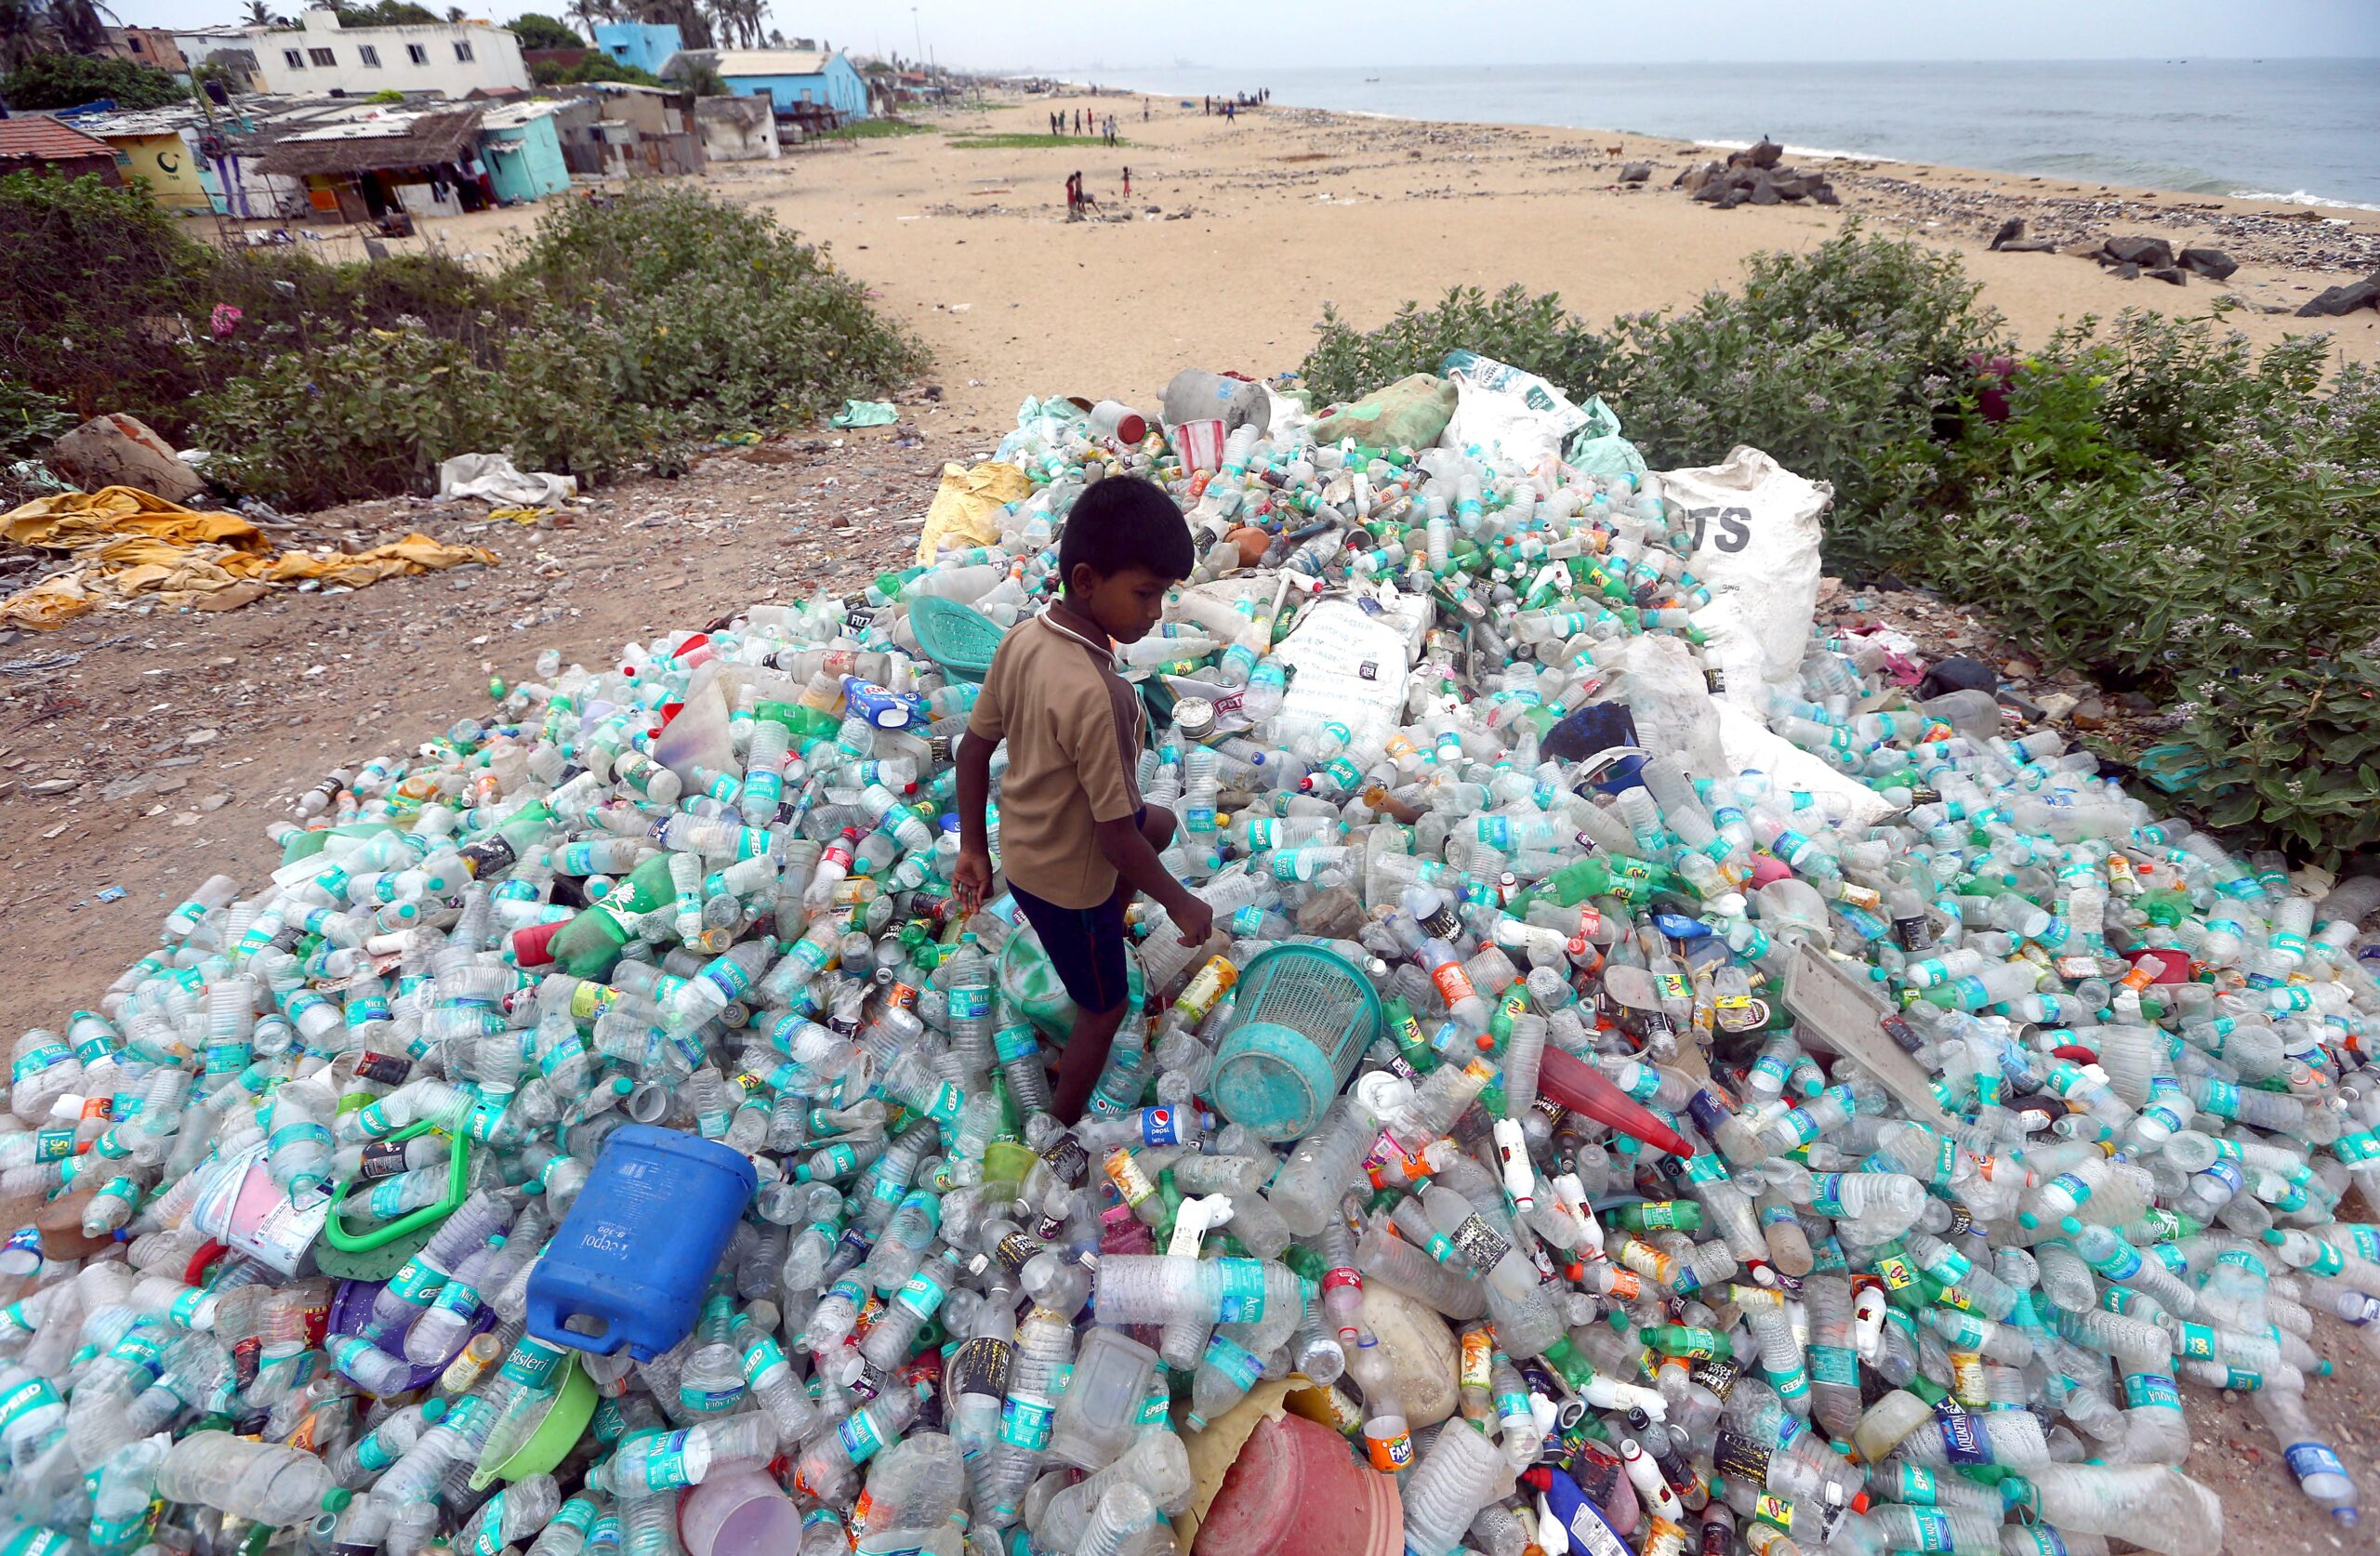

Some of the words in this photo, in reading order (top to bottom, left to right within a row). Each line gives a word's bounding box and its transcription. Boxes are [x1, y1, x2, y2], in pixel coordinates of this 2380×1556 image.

[1688, 507, 1752, 553] TS
[851, 613, 872, 626] FIZZ
[1329, 763, 1353, 779] SPEED
[1254, 818, 1266, 845] SPEED
[720, 960, 733, 974] NICE
[732, 972, 747, 990] AQUA
[365, 999, 381, 1008] NICE
[969, 992, 983, 1003] NICE
[774, 1022, 787, 1037] NICE
[364, 1111, 388, 1131] SPEED
[1944, 1141, 1952, 1171] SPEED
[459, 1287, 474, 1302] NICE
[509, 1348, 550, 1371] Bisleri
[1780, 1374, 1805, 1393] SPEED
[705, 1399, 724, 1410] AQUA
[724, 1395, 742, 1405] NICE
[2149, 1390, 2167, 1402] AQUA
[855, 1425, 871, 1444] AQUA
[651, 1432, 668, 1457] NICE
[1920, 1517, 1936, 1536] AQUA
